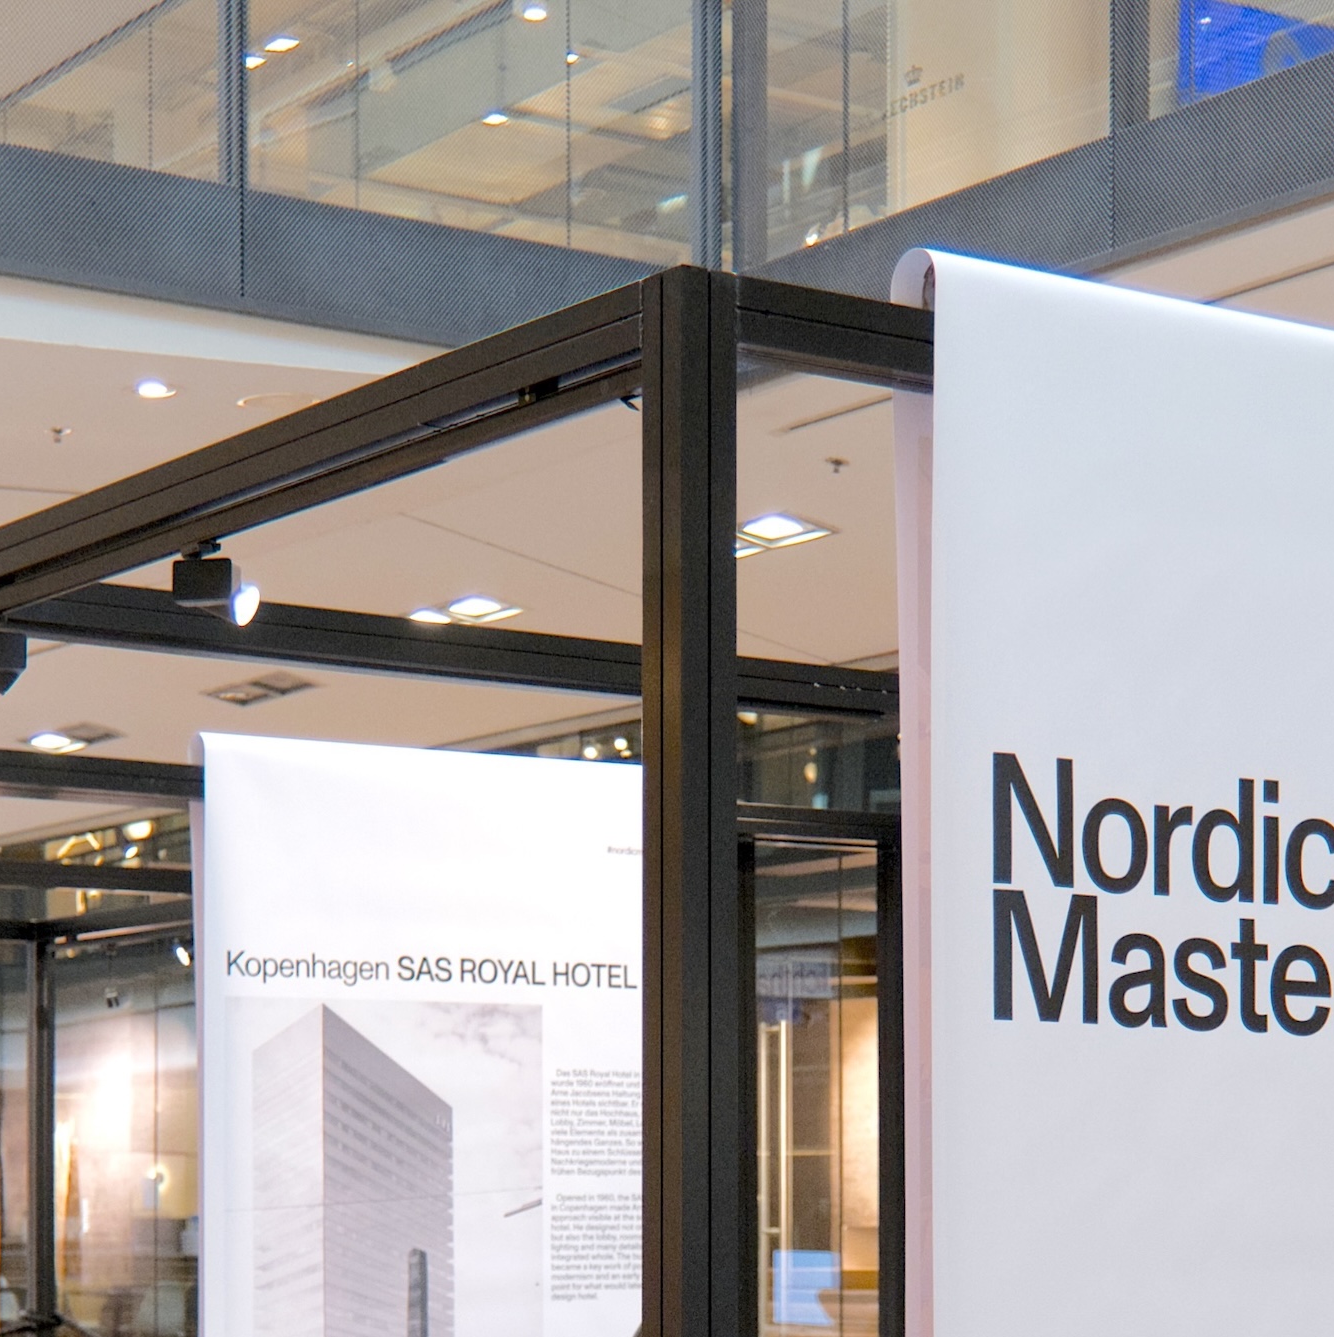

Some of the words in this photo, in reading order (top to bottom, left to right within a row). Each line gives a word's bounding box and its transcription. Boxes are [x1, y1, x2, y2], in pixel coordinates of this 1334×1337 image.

[226, 950, 389, 986] Kopenhagen
[398, 955, 452, 982] SAS
[461, 958, 545, 987] ROYAL
[553, 962, 637, 990] HOTEL
